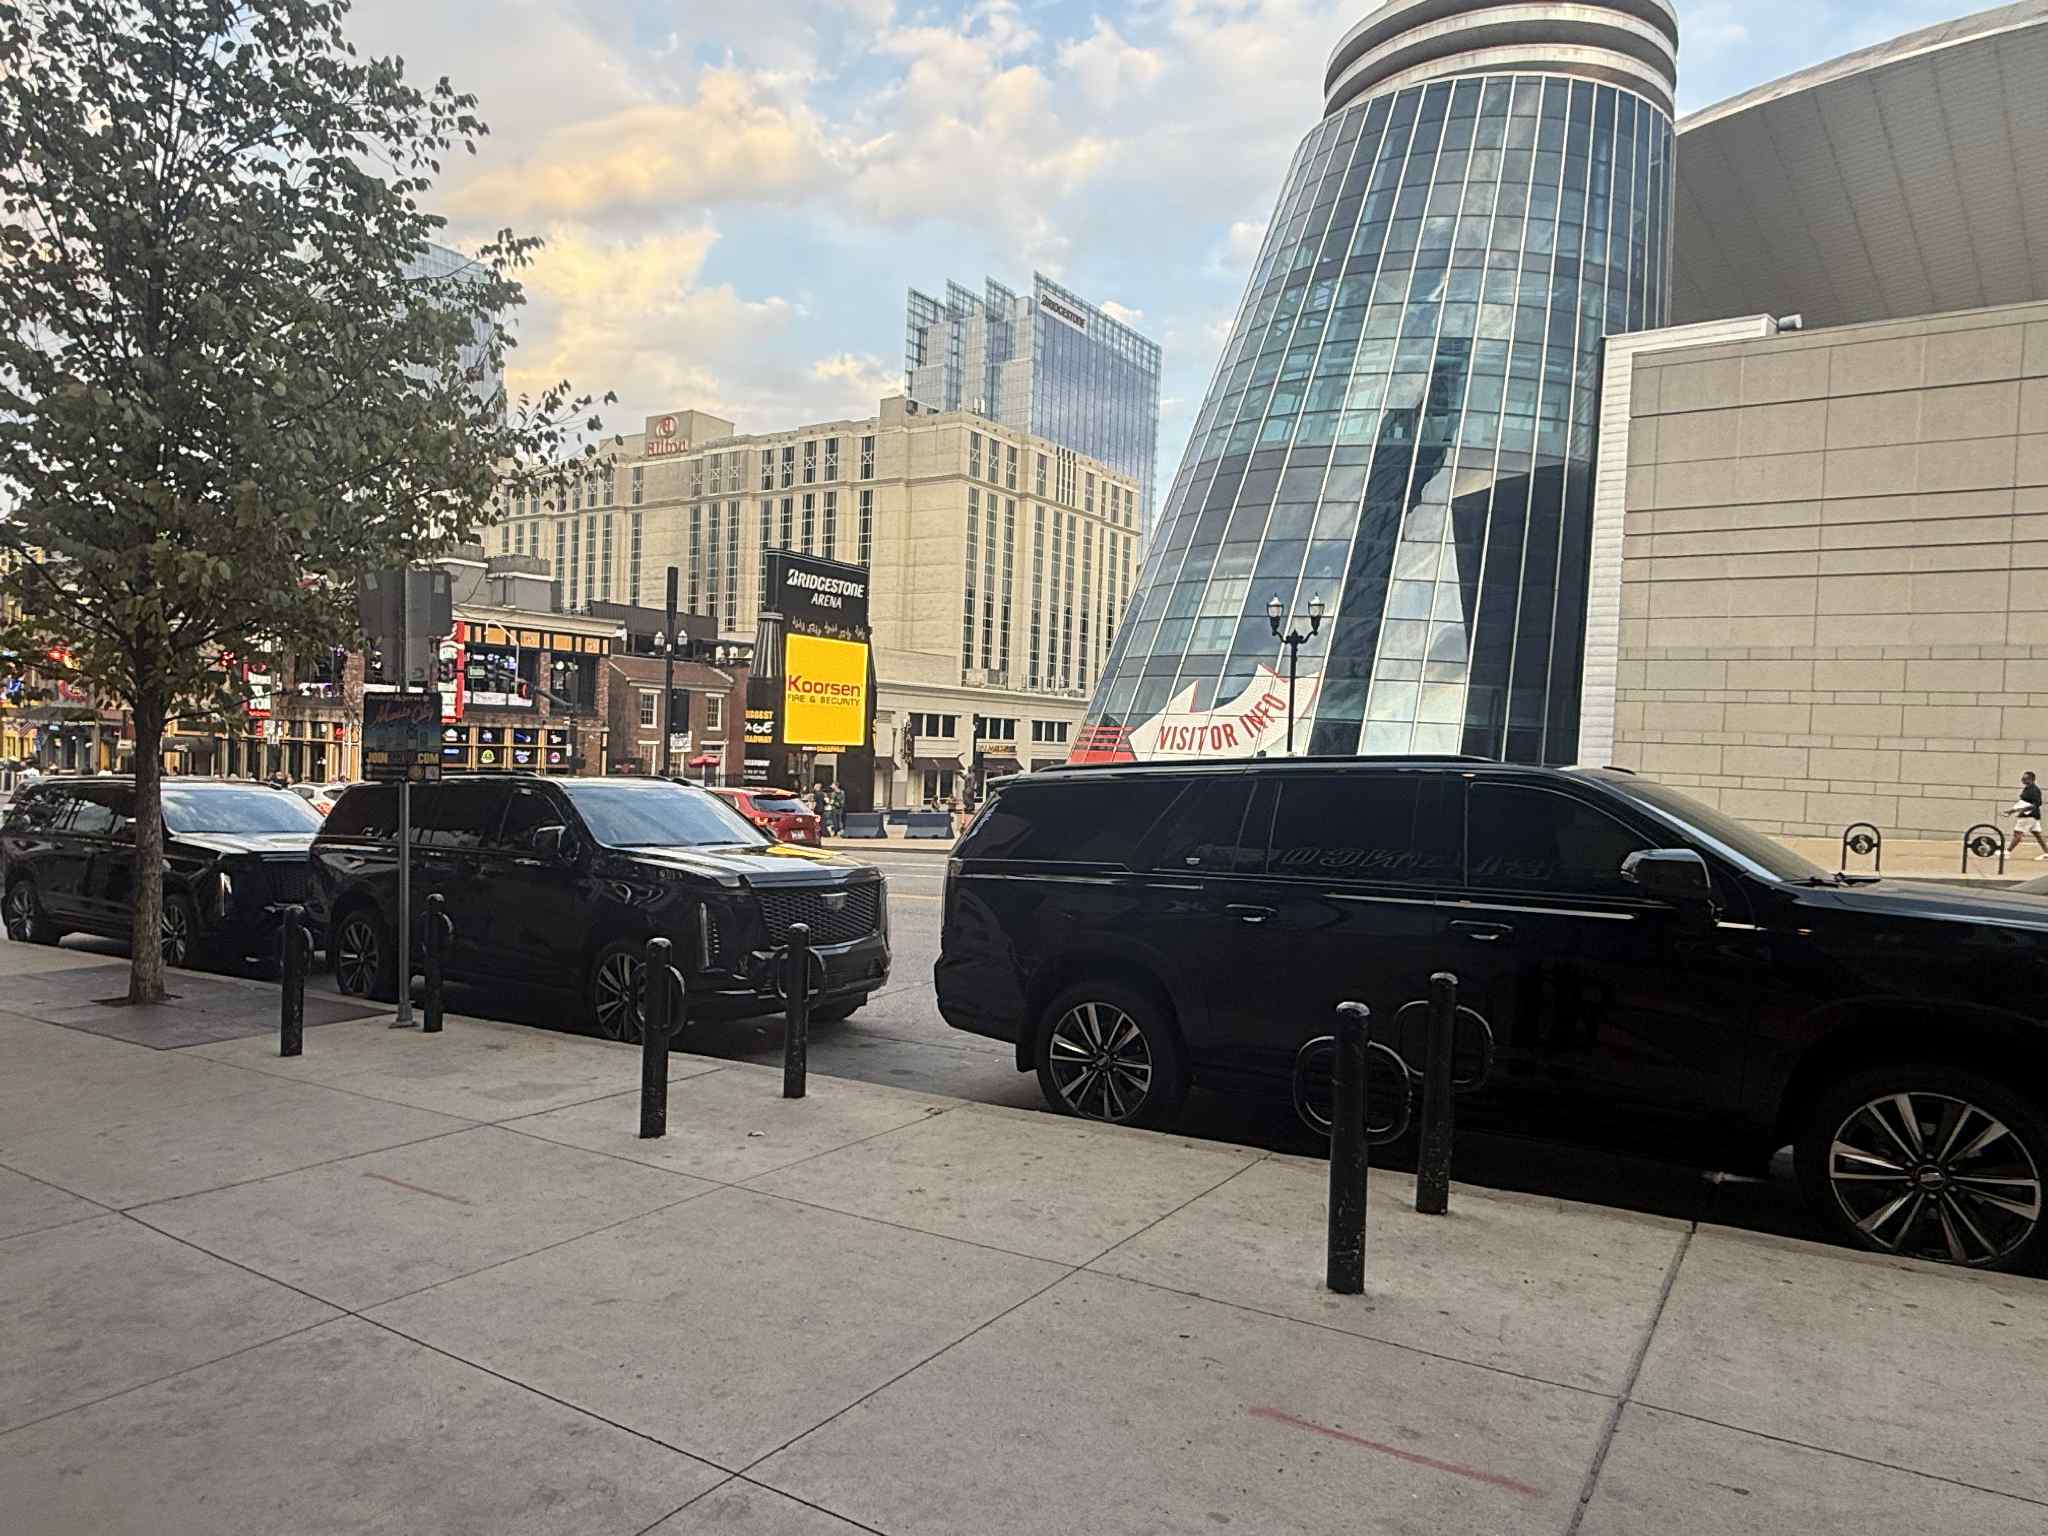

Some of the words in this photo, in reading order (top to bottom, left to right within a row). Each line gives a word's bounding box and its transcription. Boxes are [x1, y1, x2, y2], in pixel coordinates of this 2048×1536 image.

[1041, 294, 1086, 328] BRIDGESTONE
[786, 569, 865, 599] BRIDGESTONE
[811, 593, 843, 609] ARENA
[788, 675, 860, 697] Koorsen
[788, 694, 806, 703] FIRE
[809, 696, 816, 704] &
[820, 696, 861, 707] SECURITY
[1159, 724, 1239, 750] VISITOR
[1240, 693, 1286, 738] INFO
